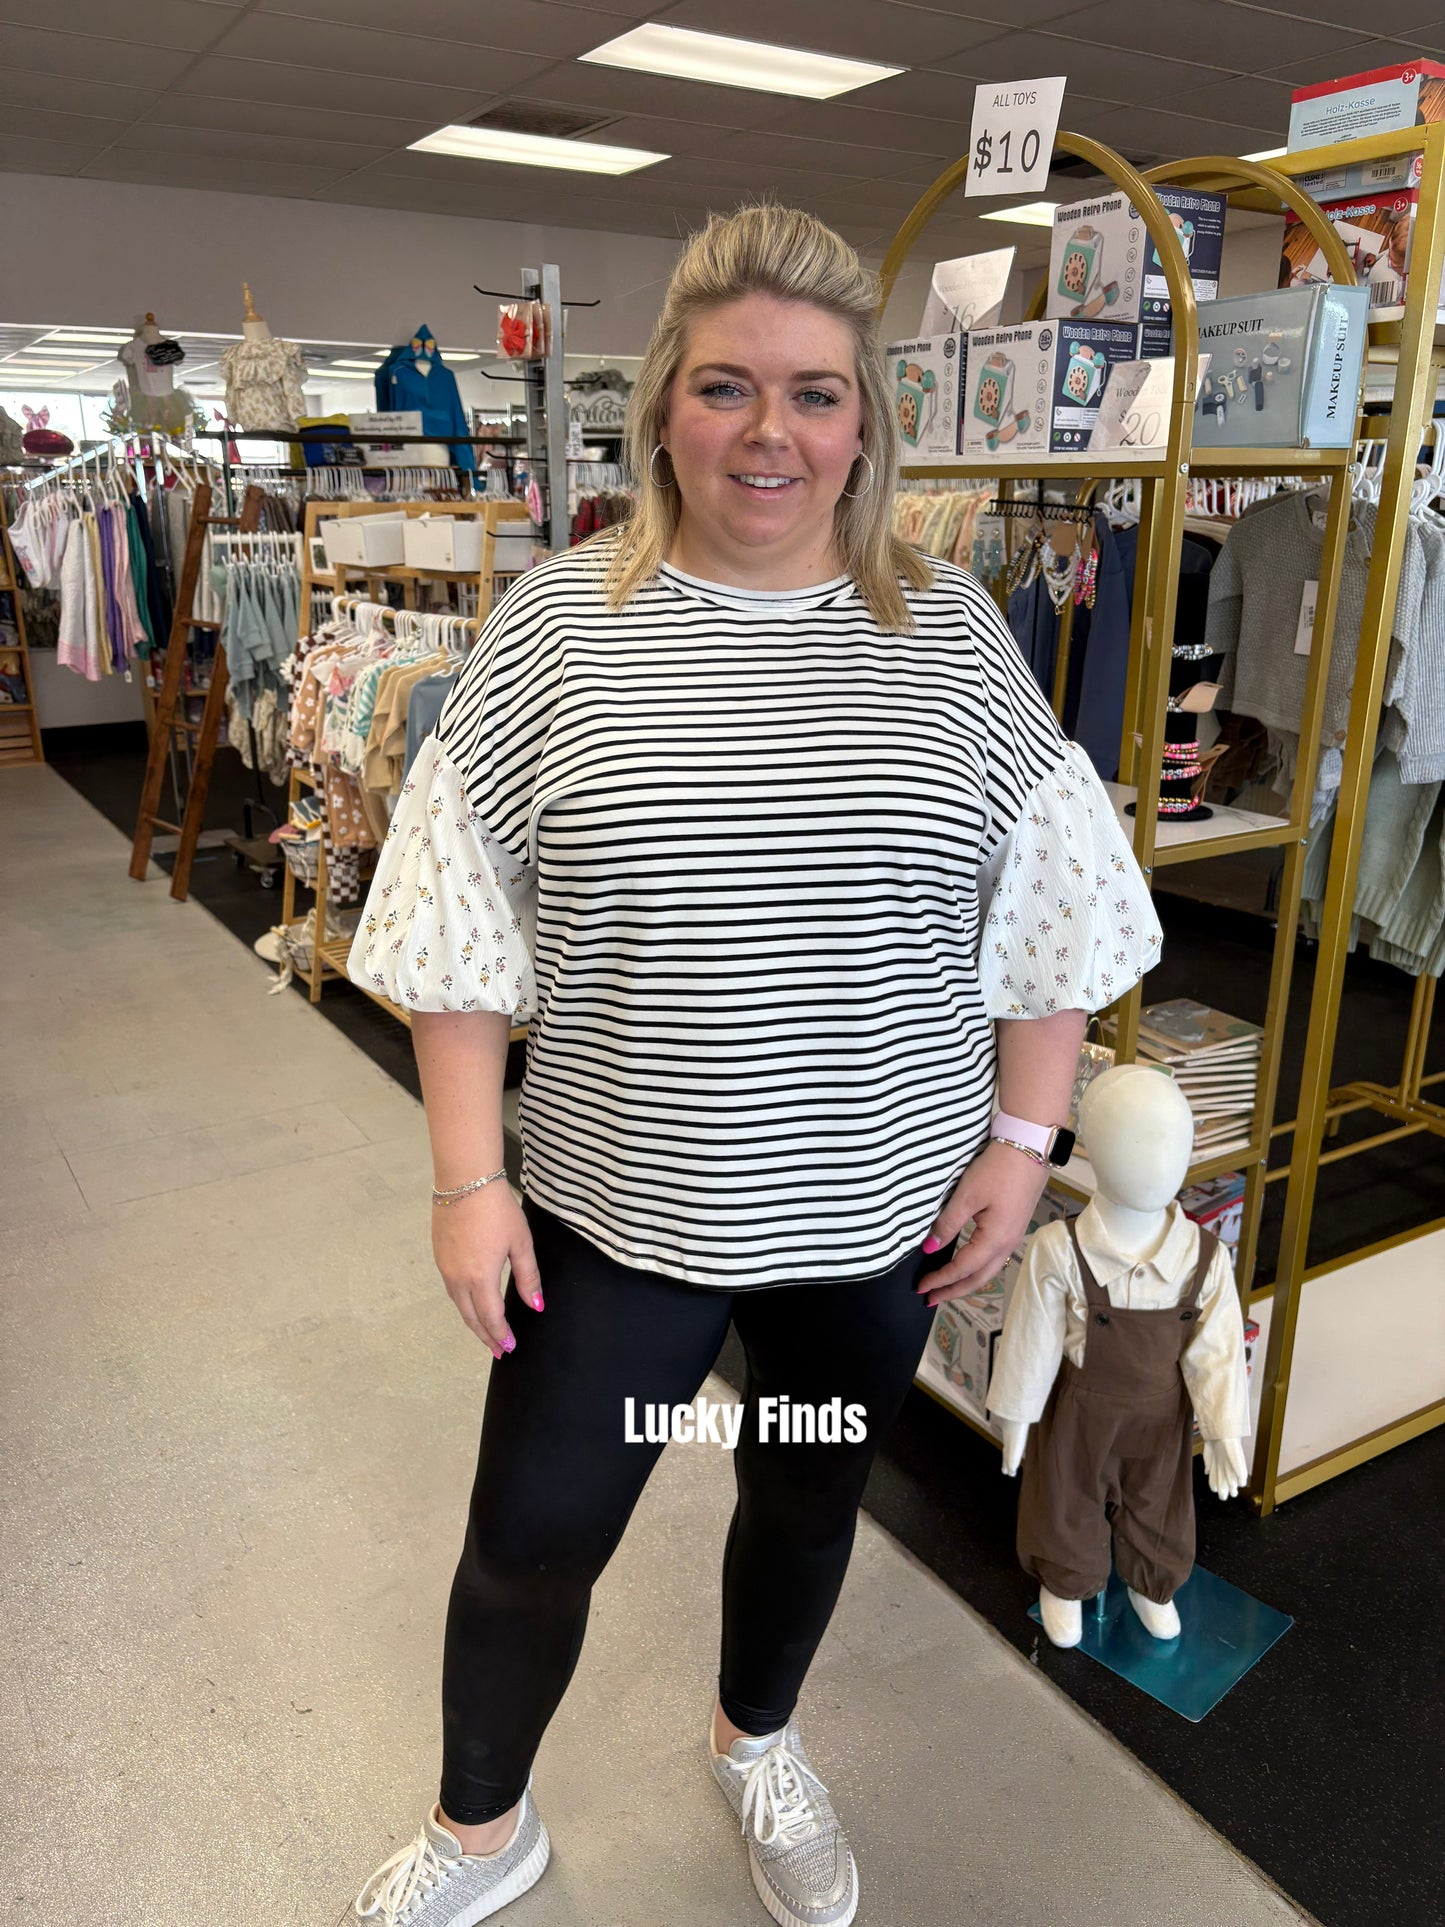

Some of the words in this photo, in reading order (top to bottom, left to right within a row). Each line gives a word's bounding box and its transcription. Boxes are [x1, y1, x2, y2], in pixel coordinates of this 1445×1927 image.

[1403, 72, 1414, 83] 3+
[992, 94, 1010, 107] ALL
[1013, 91, 1037, 106] TOYS
[1325, 97, 1376, 115] Holz-Kasse
[973, 128, 1041, 178] $10
[1057, 207, 1081, 223] Wooden
[1082, 203, 1101, 217] Retro
[1102, 198, 1122, 214] Phone
[1181, 195, 1200, 210] Retro
[1200, 197, 1221, 213] Phone
[1062, 326, 1090, 340] Wooden
[1091, 328, 1111, 342] Retro
[1111, 330, 1132, 343] Phone
[1198, 322, 1238, 339] AKEUP
[1238, 318, 1264, 333] SUIT
[972, 334, 994, 347] Wooden
[995, 332, 1013, 344] Retro
[1014, 330, 1032, 342] Phone
[1326, 352, 1345, 419] MAKEUP
